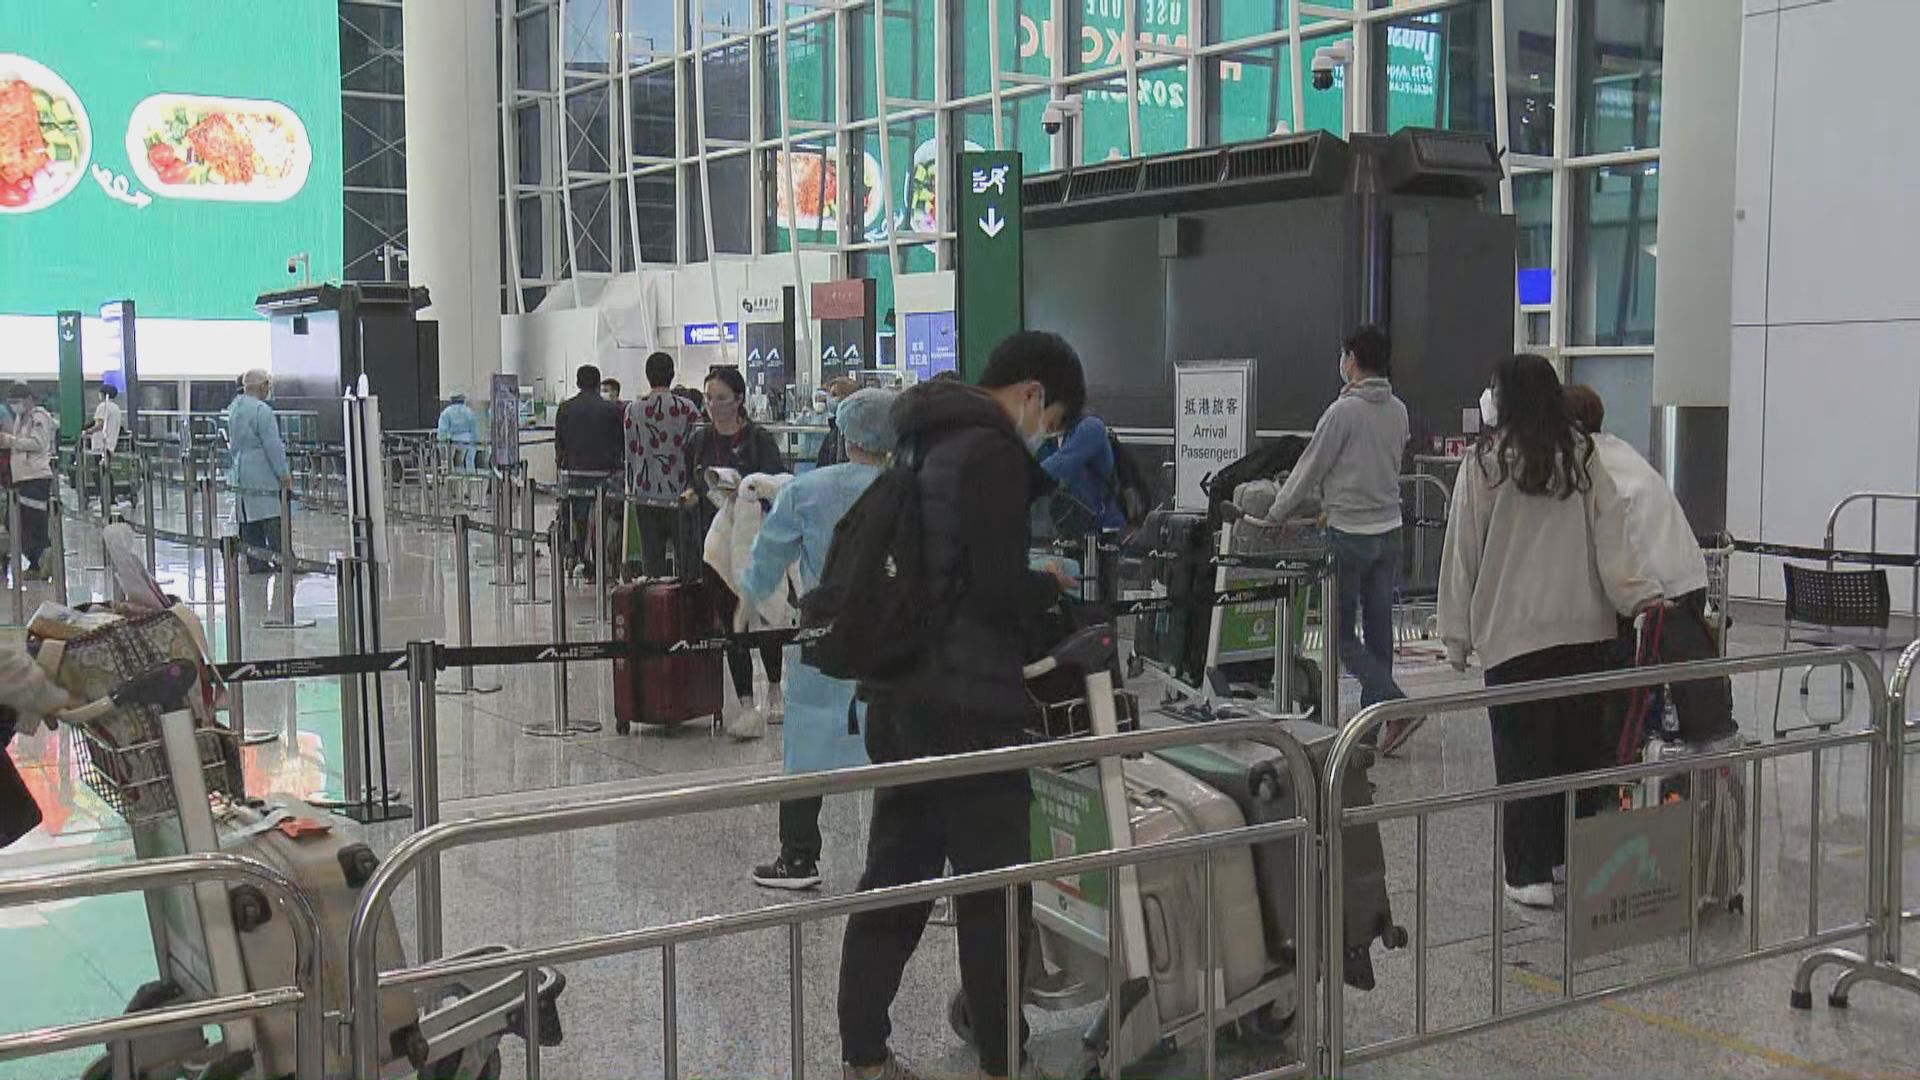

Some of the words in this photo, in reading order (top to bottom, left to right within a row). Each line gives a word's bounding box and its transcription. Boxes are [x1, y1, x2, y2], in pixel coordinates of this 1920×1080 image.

[1184, 396, 1238, 415] 抵港旅客
[1192, 424, 1227, 439] Arrival
[1181, 444, 1238, 462] Passengers
